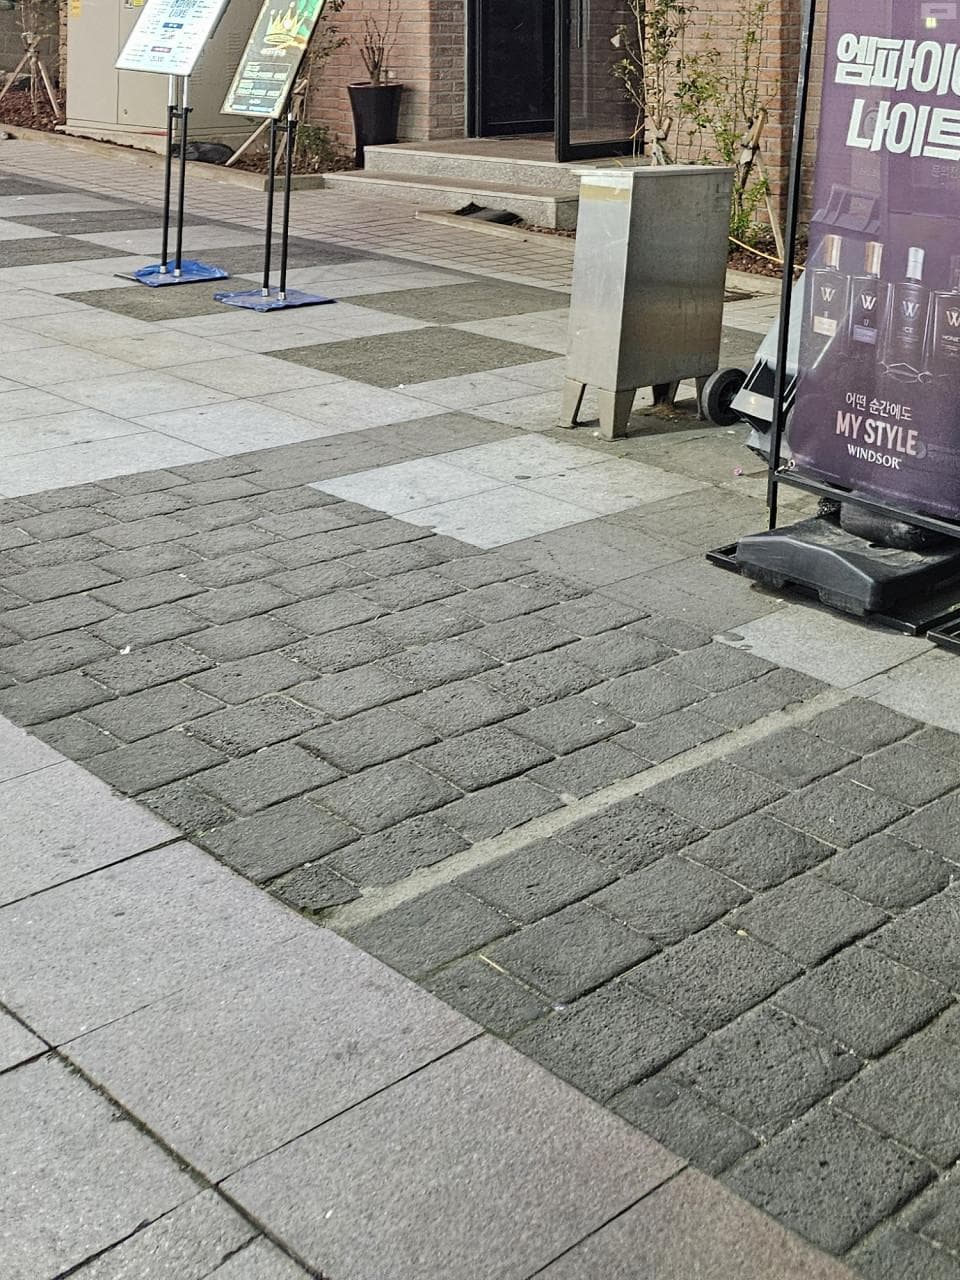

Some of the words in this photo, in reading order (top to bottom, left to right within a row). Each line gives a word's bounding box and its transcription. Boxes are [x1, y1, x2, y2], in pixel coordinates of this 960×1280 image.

[845, 392, 867, 412] 어떤
[868, 400, 914, 421] 순간에도
[836, 410, 864, 440] MY
[863, 418, 919, 456] STYLE
[847, 443, 902, 470] WINDSOR
